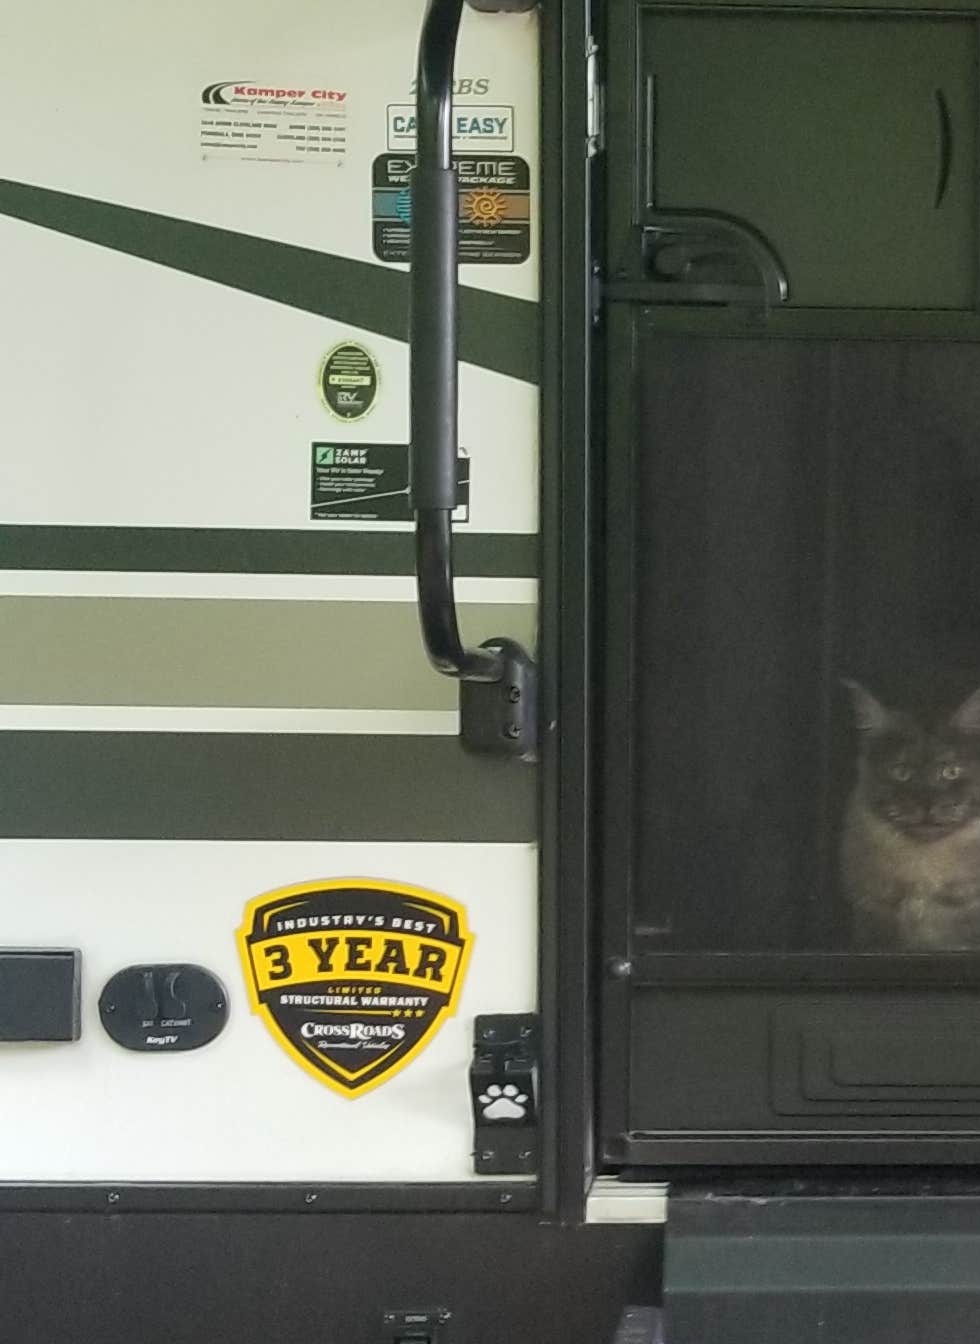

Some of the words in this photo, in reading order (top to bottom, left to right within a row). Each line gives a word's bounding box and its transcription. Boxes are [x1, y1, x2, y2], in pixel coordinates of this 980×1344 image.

[233, 86, 306, 99] Kamper
[311, 89, 347, 102] City
[456, 117, 507, 133] EASY
[335, 448, 368, 456] ZAMP
[335, 456, 367, 464] SOLAR
[276, 914, 385, 932] INDUSTRY'S
[391, 917, 437, 934] BEST
[263, 944, 293, 981] 3
[307, 936, 447, 983] YEAR
[280, 994, 359, 1006] STRUCTURAL
[360, 996, 430, 1007] WARRANTY
